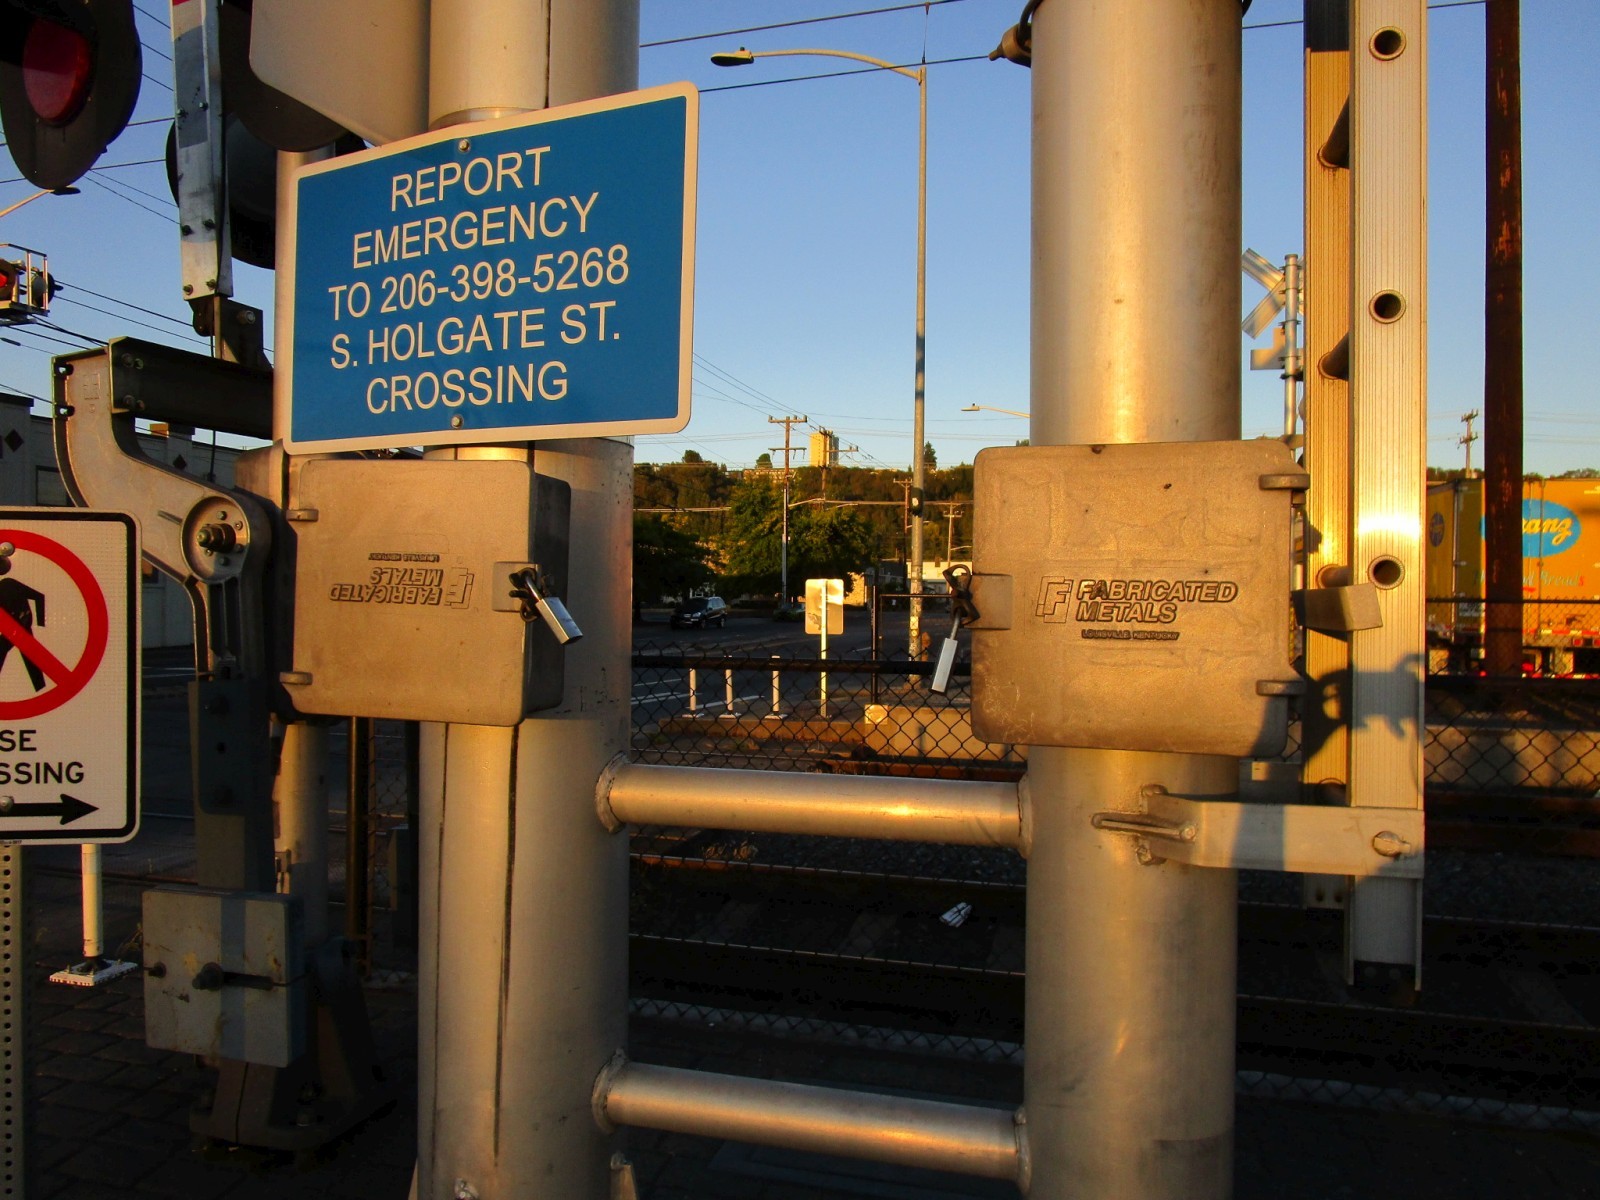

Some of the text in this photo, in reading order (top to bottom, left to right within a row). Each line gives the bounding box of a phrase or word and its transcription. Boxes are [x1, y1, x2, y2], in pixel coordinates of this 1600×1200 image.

[391, 146, 551, 212] REPORT
[353, 192, 599, 269] EMERGENCY
[328, 244, 629, 321] TO 206-398-5268
[330, 300, 621, 369] S. HOLGATE ST.
[366, 361, 568, 415] CROSSING
[329, 583, 443, 606] FABRICATED
[369, 567, 444, 586] METALS
[1076, 578, 1238, 603] FABRICATED
[1075, 600, 1177, 624] METALS
